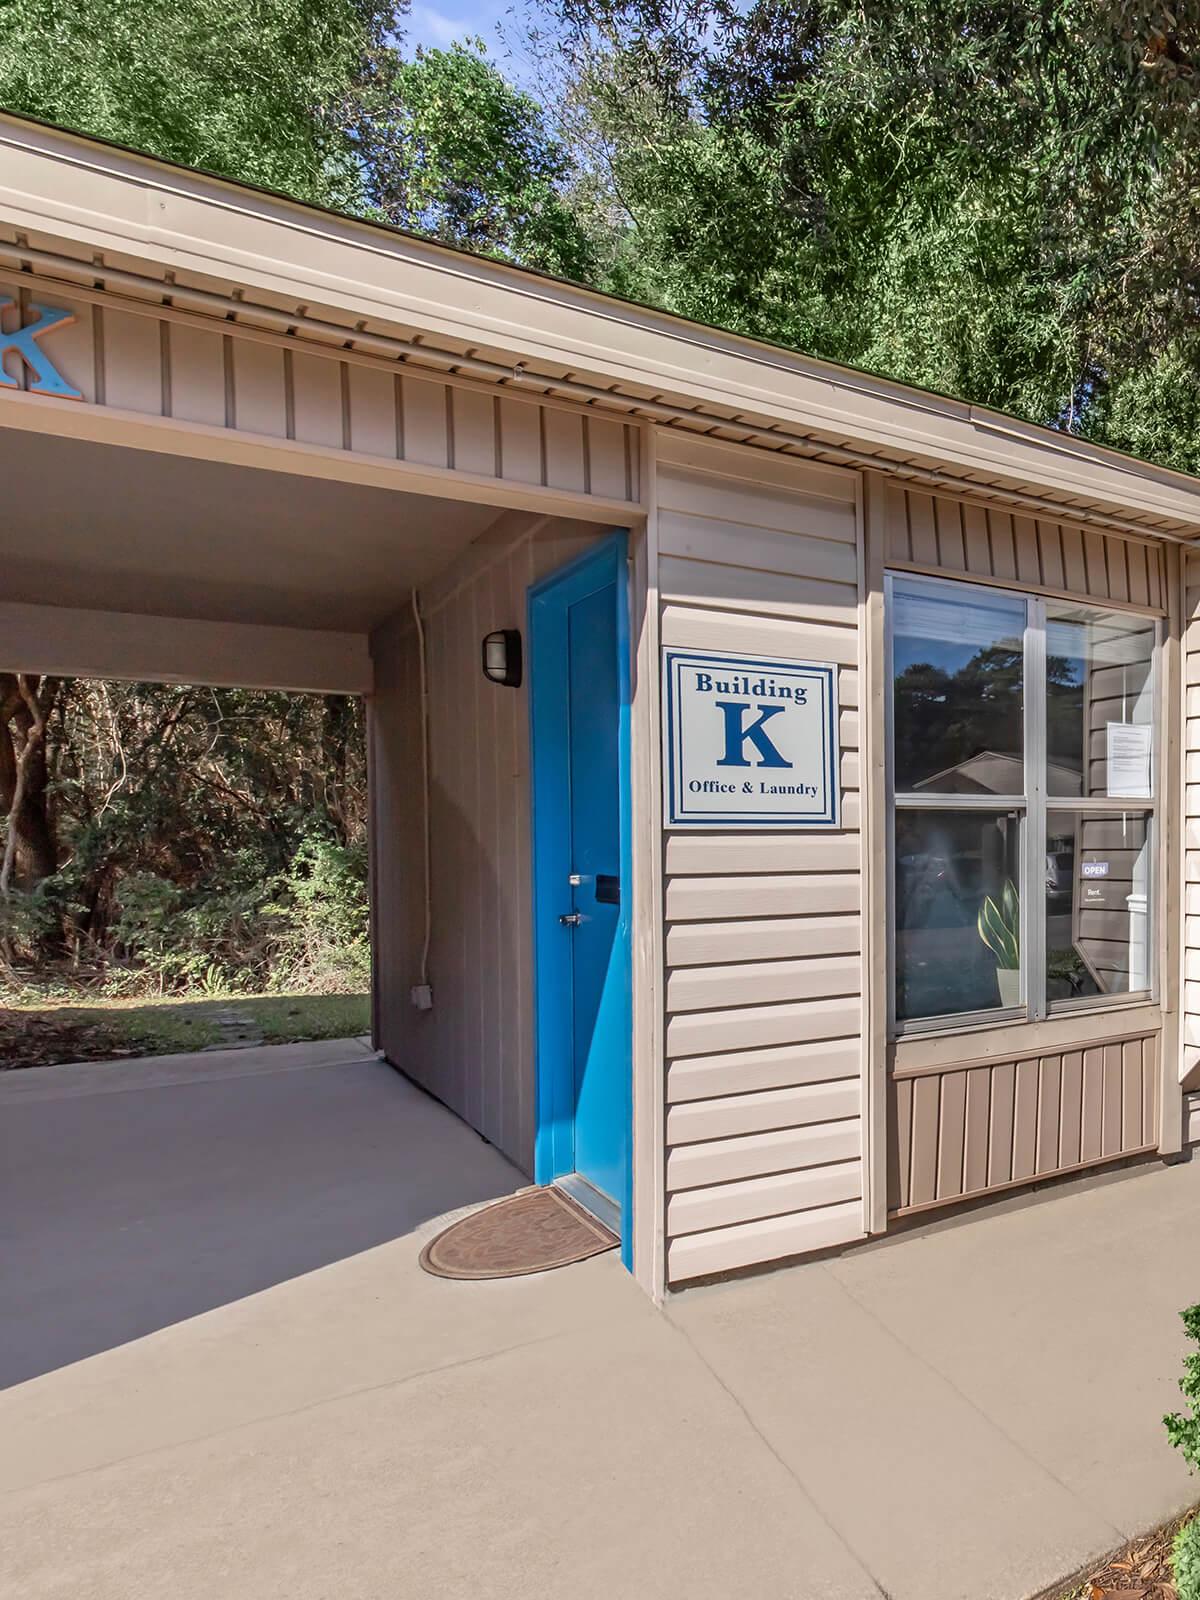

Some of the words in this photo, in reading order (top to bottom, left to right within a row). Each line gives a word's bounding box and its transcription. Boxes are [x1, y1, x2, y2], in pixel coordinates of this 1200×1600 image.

[0, 296, 84, 399] K
[695, 673, 808, 705] Building
[715, 701, 793, 768] K
[689, 779, 737, 794] Office
[742, 781, 754, 794] &
[760, 782, 818, 798] Laundry
[1084, 866, 1105, 874] OPEN
